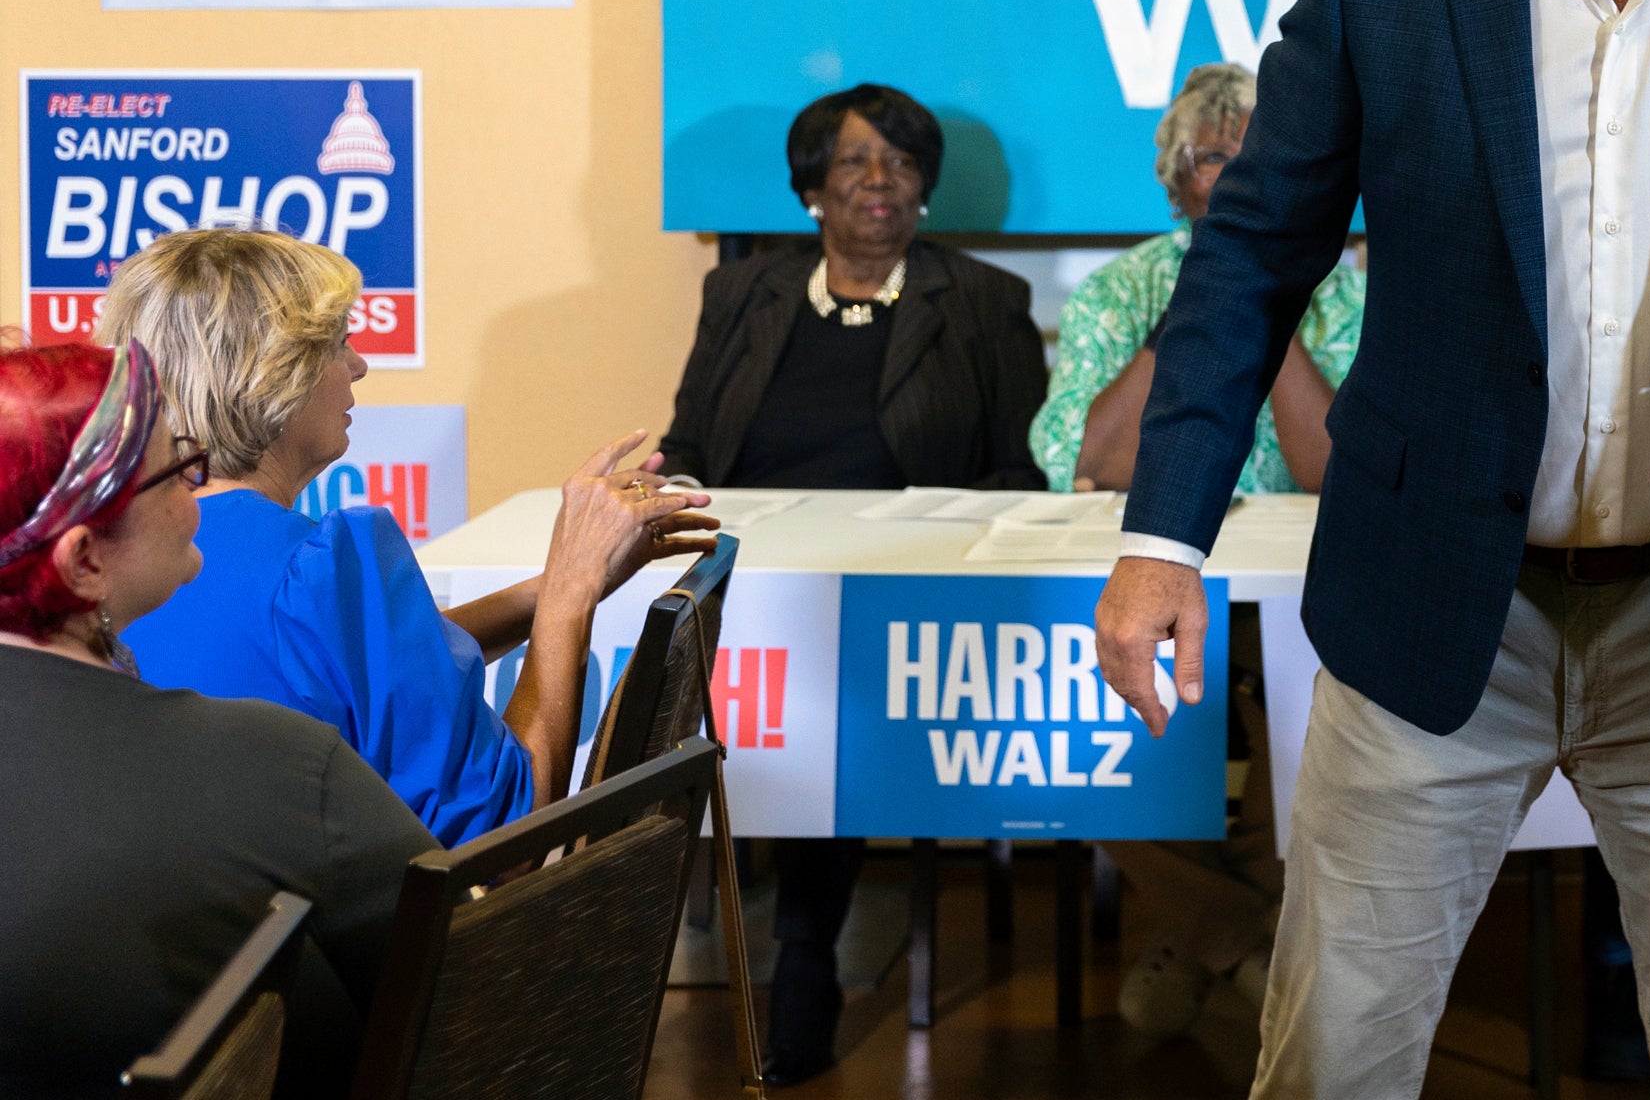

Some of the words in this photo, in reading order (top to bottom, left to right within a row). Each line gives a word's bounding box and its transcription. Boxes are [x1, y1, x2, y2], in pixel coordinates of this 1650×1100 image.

[48, 94, 171, 118] RE-ELECT
[54, 127, 229, 161] SANFORD
[928, 728, 1133, 788] WALZ
